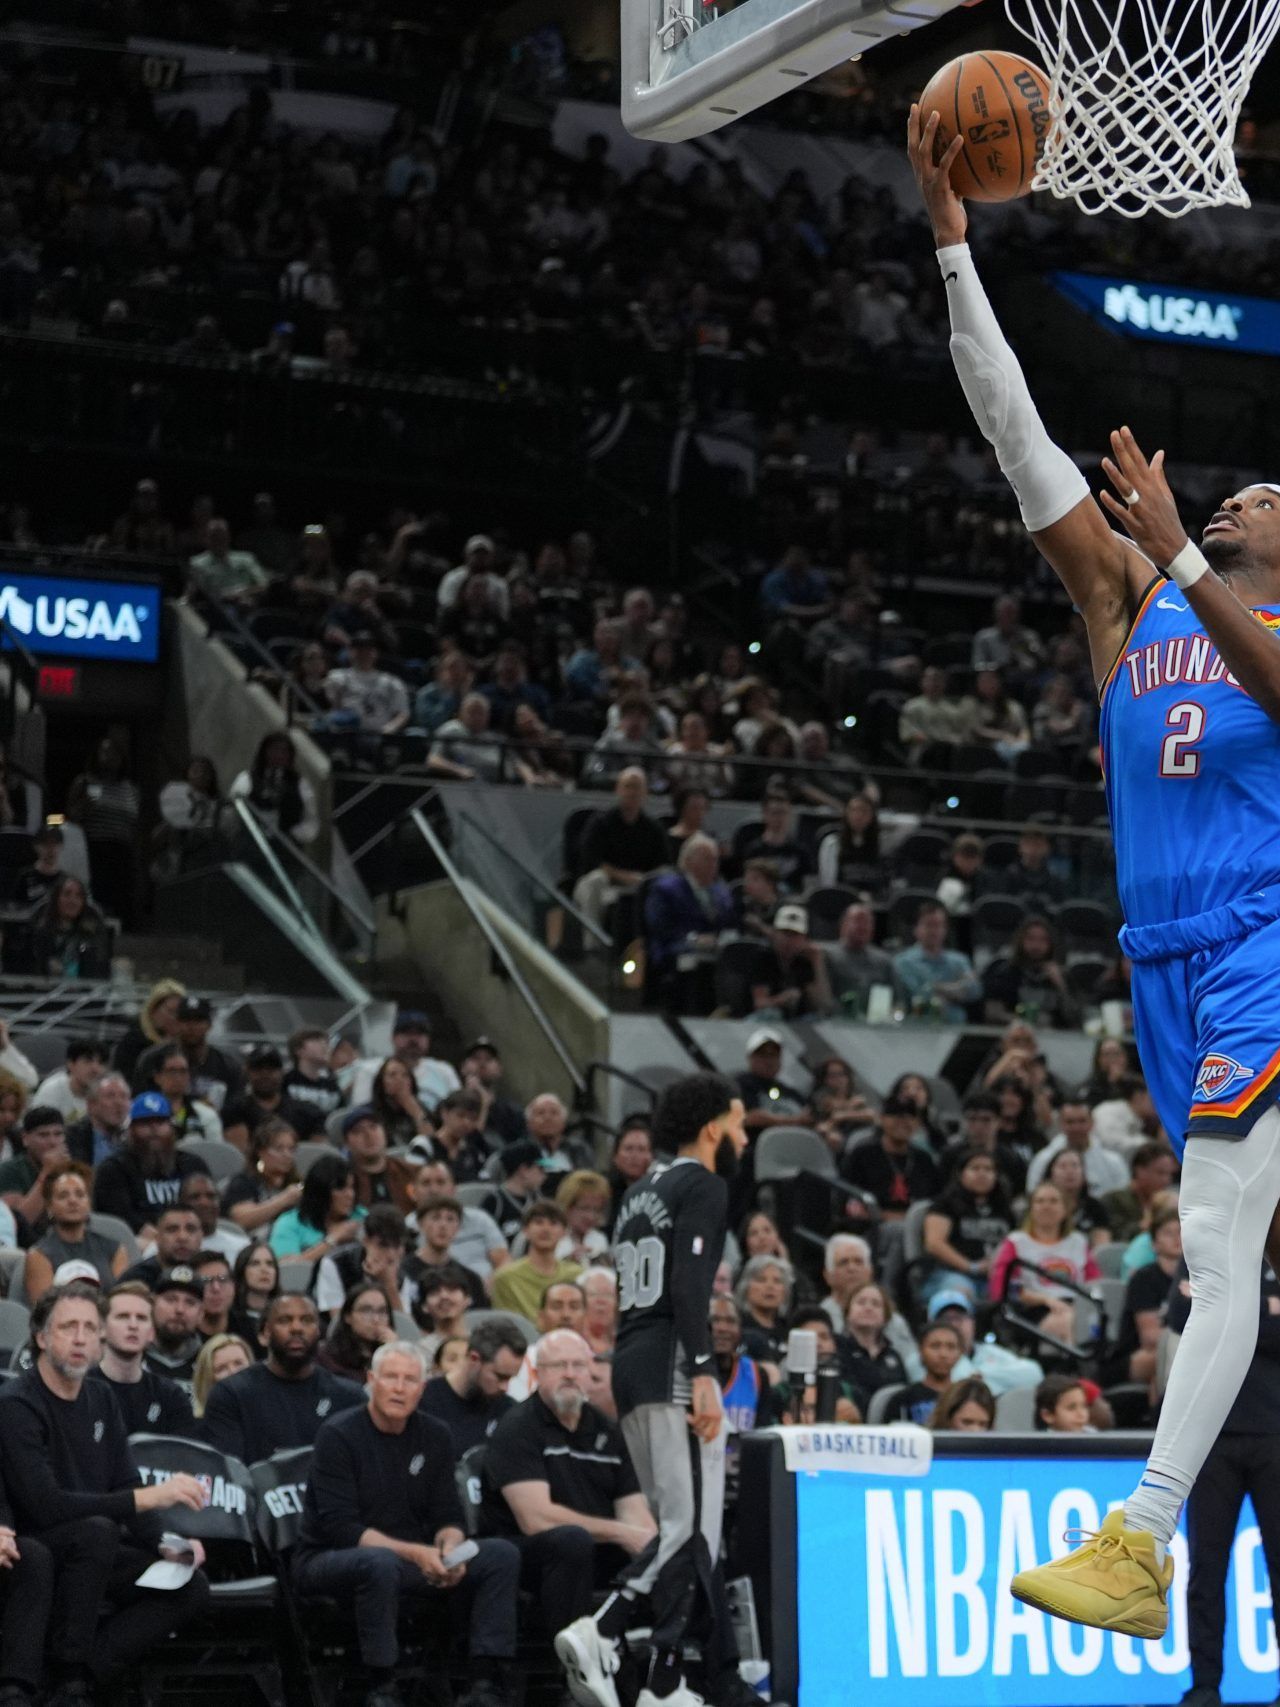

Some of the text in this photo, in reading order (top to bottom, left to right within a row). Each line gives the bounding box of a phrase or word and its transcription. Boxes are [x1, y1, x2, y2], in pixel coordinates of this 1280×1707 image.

[1150, 295, 1239, 341] USAA
[36, 595, 142, 642] USAA
[1125, 634, 1250, 698] THUND
[1159, 700, 1206, 778] 2
[1196, 1065, 1227, 1087] OKC
[813, 1433, 918, 1459] BASKETBALL
[264, 1484, 304, 1518] GET
